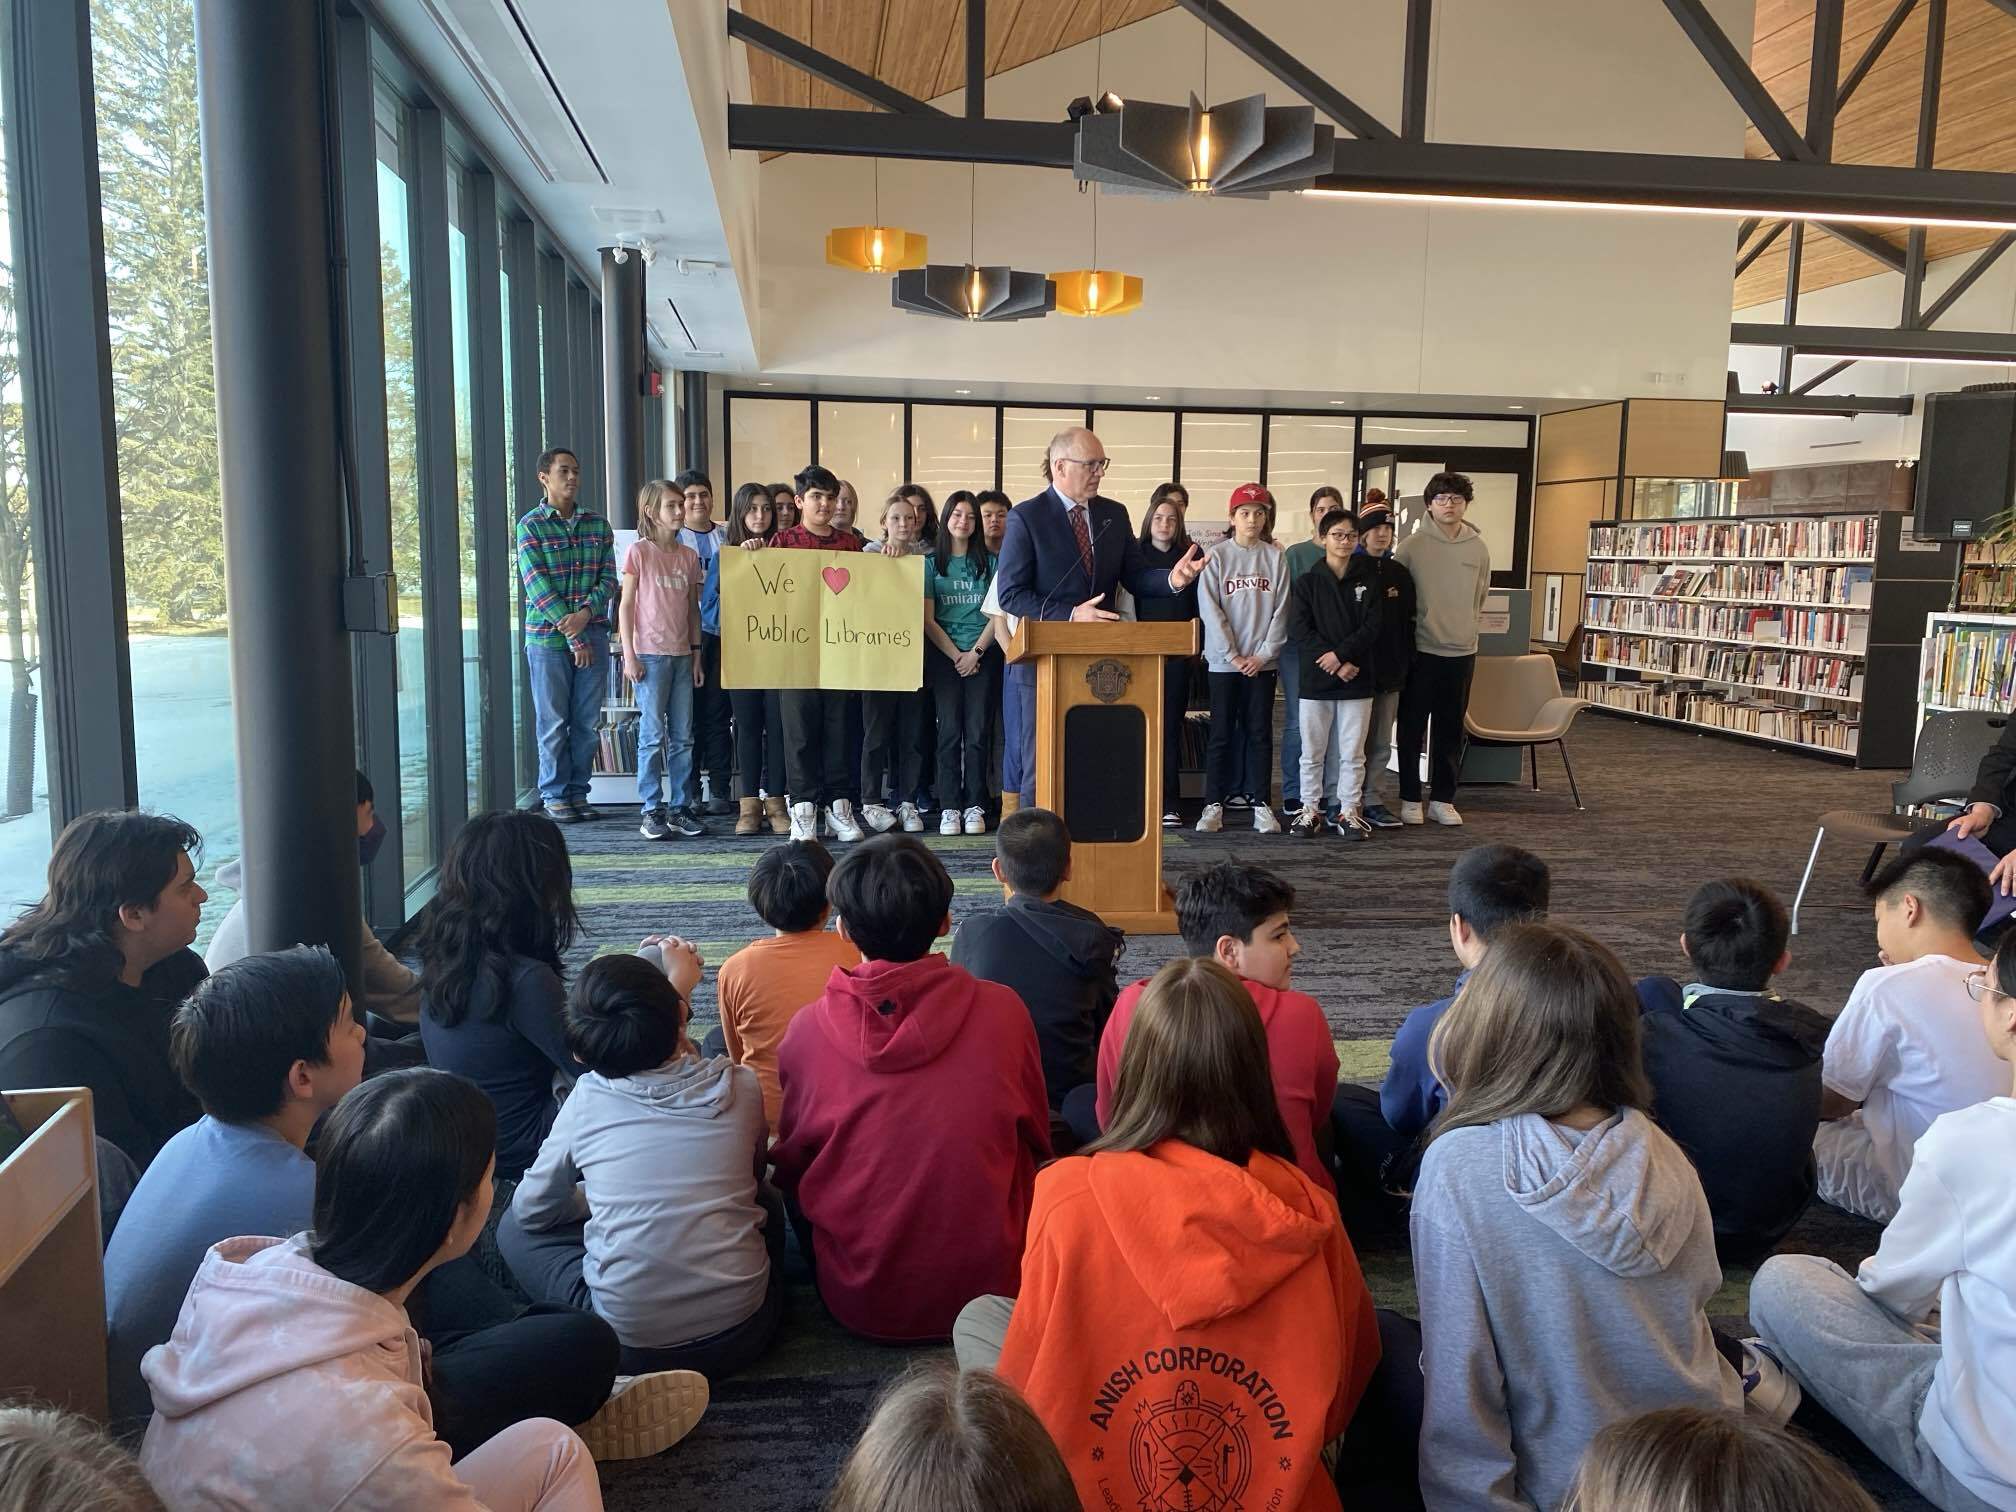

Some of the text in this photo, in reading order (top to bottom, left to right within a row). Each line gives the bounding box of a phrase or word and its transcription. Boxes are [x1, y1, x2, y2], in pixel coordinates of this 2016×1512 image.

[753, 563, 795, 595] We
[953, 580, 973, 591] Fly
[1224, 577, 1271, 596] DENVER
[940, 592, 985, 605] Emirate
[747, 614, 911, 647] Public Libraries
[1089, 1346, 1293, 1440] ANISH CORPORATION
